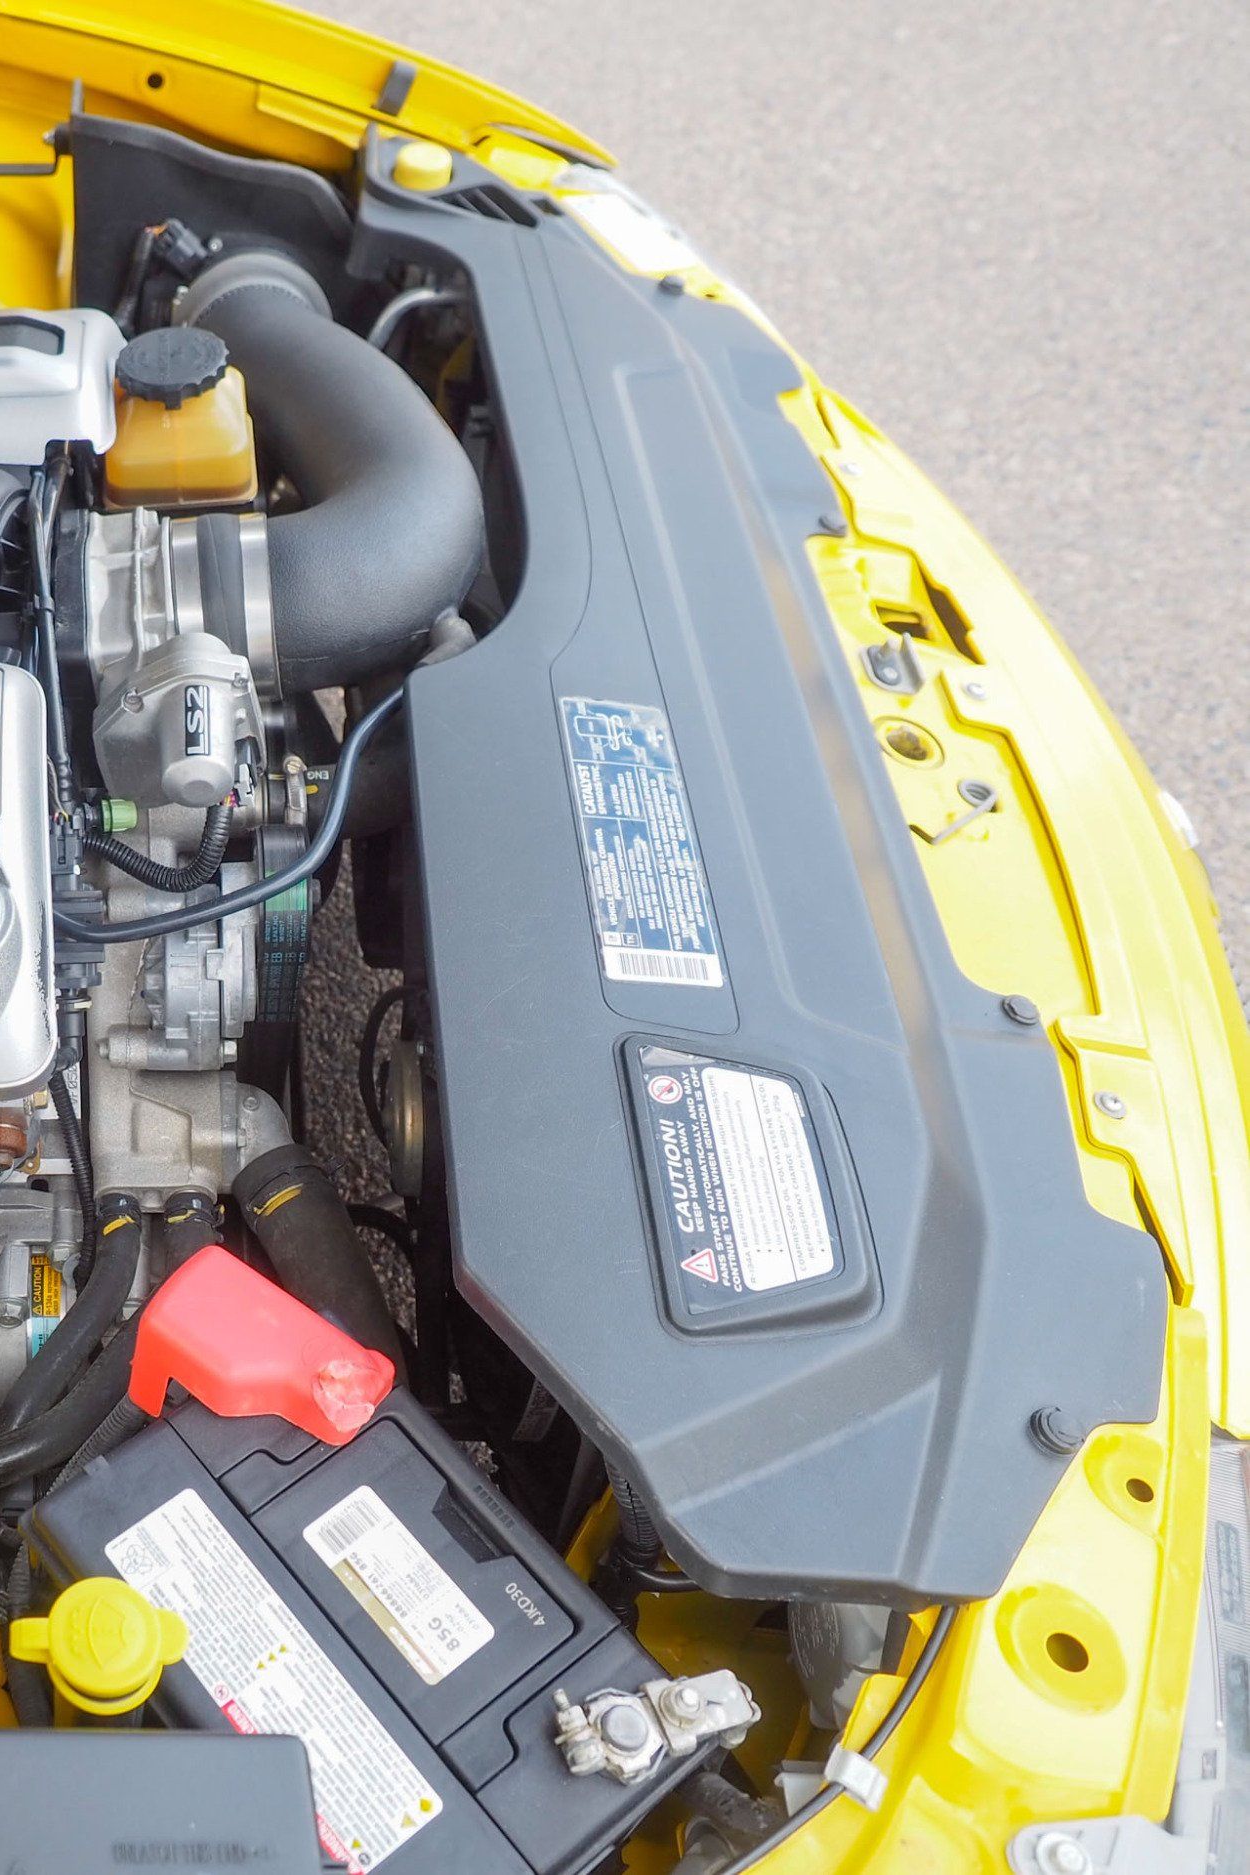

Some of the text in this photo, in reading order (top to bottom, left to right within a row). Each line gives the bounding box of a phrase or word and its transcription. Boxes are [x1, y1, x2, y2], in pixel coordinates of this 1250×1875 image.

[186, 686, 205, 755] LS2
[306, 770, 330, 780] ENG
[576, 763, 597, 814] CATALYST
[593, 826, 607, 859] CONTROL
[598, 859, 613, 895] EMISSION
[605, 851, 622, 900] INFORMATION
[605, 894, 619, 925] VEHICLE
[667, 908, 680, 934] VEHICLE
[680, 1070, 693, 1095] MAY
[705, 1072, 724, 1122] PRESSURE
[756, 1080, 771, 1114] GLYCOL
[685, 1095, 698, 1120] AND
[716, 1123, 728, 1146] HIGH
[675, 1119, 706, 1232] KEEP HANDS AWAY
[688, 1065, 743, 1293] CONTINUE TO RUN WHEN IGNITION IS OFF
[721, 1147, 735, 1180] UNDER
[784, 1153, 800, 1190] CHARGE
[708, 1212, 724, 1251] START
[729, 1182, 750, 1248] REFRIGERANT
[793, 1192, 816, 1260] REFRIGERANT
[784, 1204, 807, 1272] COMPRESSOR
[33, 1266, 42, 1303] CAUTION
[716, 1253, 732, 1287] FANS
[504, 1581, 548, 1629] 4JKD30
[425, 1614, 462, 1653] 85G
